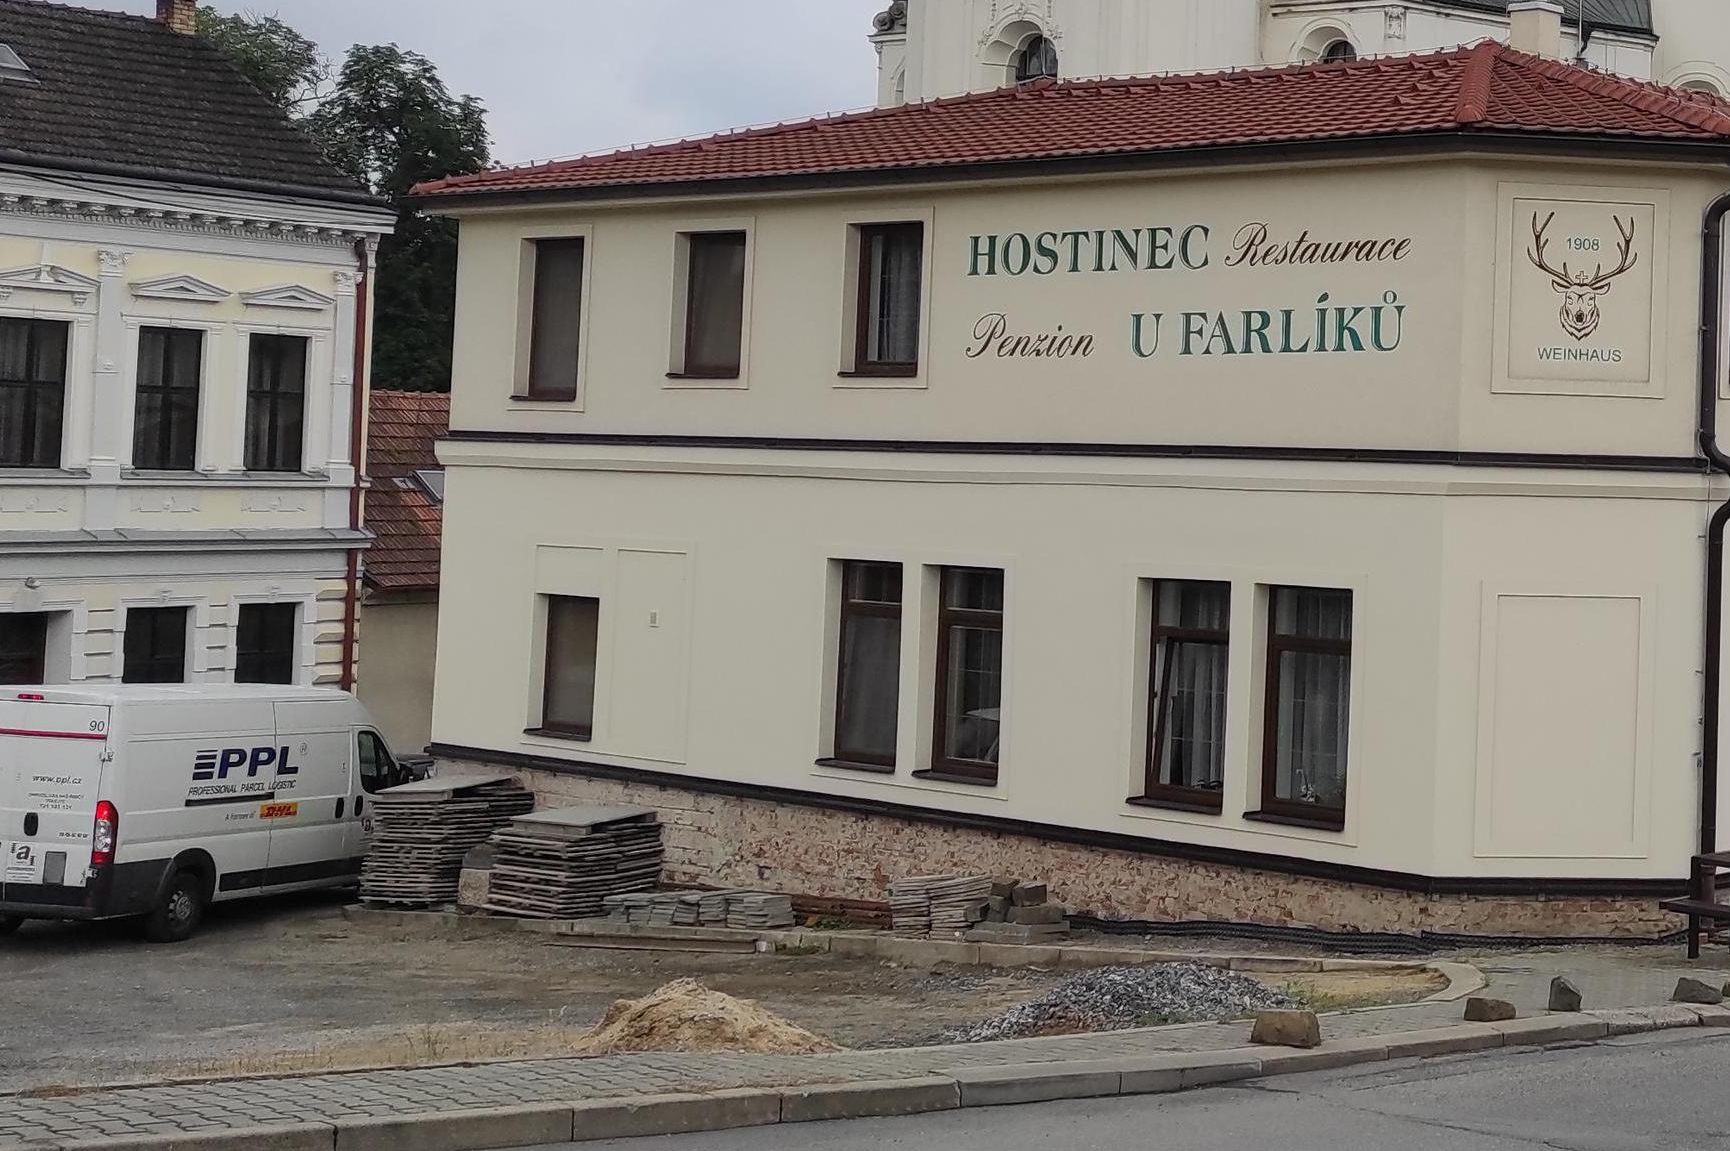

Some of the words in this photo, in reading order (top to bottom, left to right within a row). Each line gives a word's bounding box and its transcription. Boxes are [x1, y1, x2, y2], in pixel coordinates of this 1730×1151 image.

[967, 225, 1210, 276] HOSTINEC
[1224, 221, 1412, 267] Restaurace
[1566, 237, 1600, 251] 1908
[965, 311, 1095, 359] Penzion
[1130, 312, 1161, 357] U
[1178, 290, 1407, 356] FARLÍKŮ
[1537, 347, 1622, 362] WEINHAUS
[89, 720, 105, 732] 90
[217, 746, 299, 779] PPL
[188, 784, 237, 796] PROFESSIONAL
[241, 782, 265, 792] PARCEL
